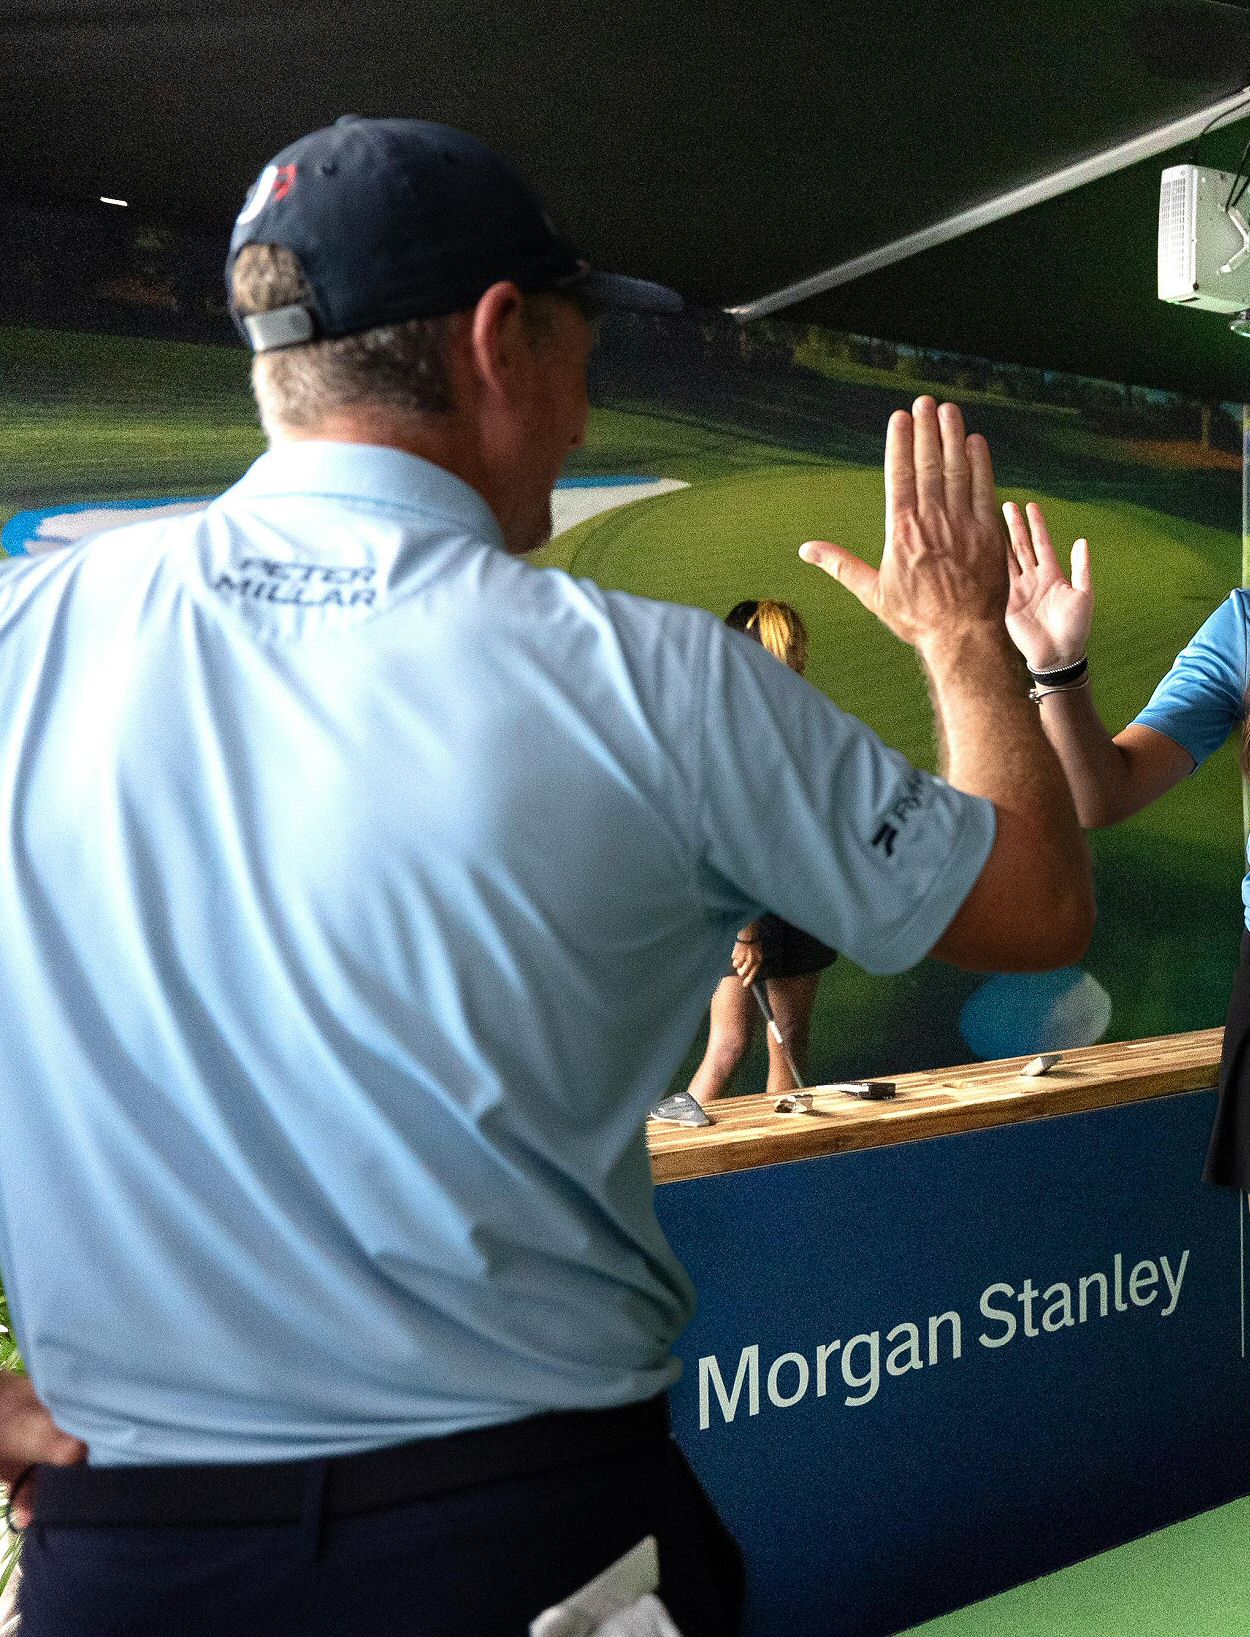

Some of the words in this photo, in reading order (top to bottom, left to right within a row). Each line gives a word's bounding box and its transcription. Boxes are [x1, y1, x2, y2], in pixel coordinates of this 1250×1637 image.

[239, 558, 376, 584] PETER
[213, 574, 377, 607] MILLAR
[698, 1308, 962, 1431] Morgan
[978, 1249, 1190, 1349] Stanley
